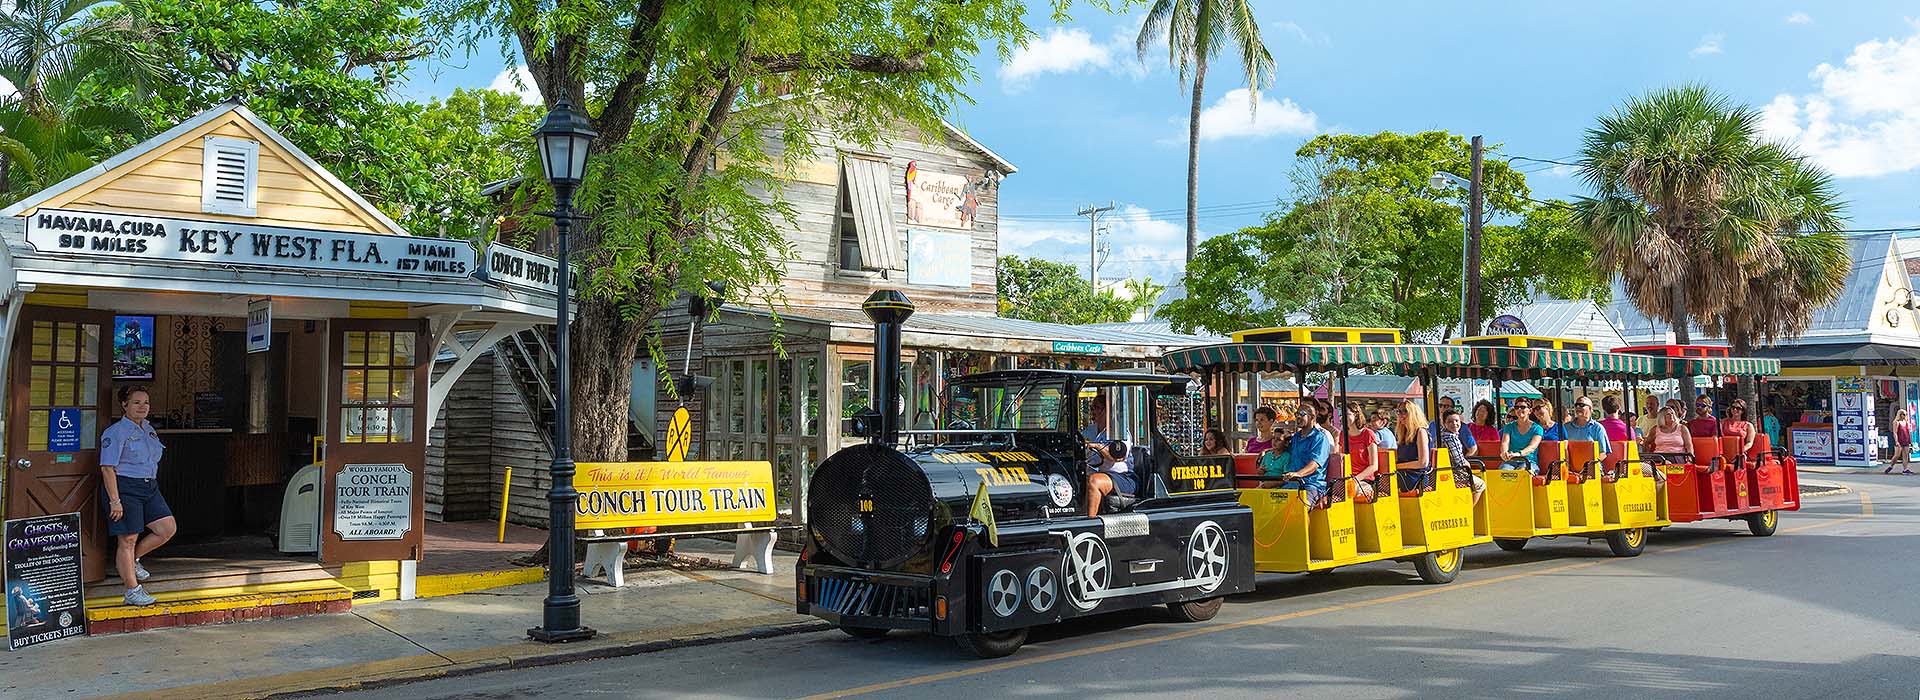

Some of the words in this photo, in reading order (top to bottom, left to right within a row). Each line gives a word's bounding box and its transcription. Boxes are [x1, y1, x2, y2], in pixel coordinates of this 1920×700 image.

[920, 180, 959, 195] Caribbean
[932, 194, 955, 210] Cargo
[58, 234, 85, 248] 90
[90, 236, 148, 253] MILES
[179, 227, 242, 255] KEY
[331, 239, 389, 265] FLA.
[408, 243, 456, 259] MIAMI
[396, 258, 420, 271] 157
[424, 260, 467, 274] MILES
[491, 251, 524, 278] CONCH
[525, 259, 550, 284] TOUR
[1488, 327, 1526, 336] MALLORY
[668, 428, 675, 445] R
[683, 431, 689, 447] R
[932, 451, 991, 464] CONCH
[988, 451, 1039, 462] TOUR
[351, 474, 397, 485] CONCH
[588, 467, 613, 482] This
[620, 469, 630, 481] is
[635, 467, 653, 481] it!
[661, 466, 700, 481] World
[703, 467, 750, 480] Famous
[976, 467, 1031, 487] TRAIN
[1171, 465, 1208, 480] OVERSEAS
[1209, 464, 1225, 478] R.R.
[339, 486, 370, 496] TOUR
[374, 486, 410, 496] TRAIN
[1193, 478, 1205, 490] 108
[575, 489, 646, 515] CONCH
[652, 488, 706, 512] TOUR
[709, 487, 766, 511] TRAIN
[859, 499, 873, 512] 108
[24, 522, 63, 536] GHOSTS
[1430, 518, 1458, 531] OVERSEAS
[8, 531, 79, 550] GRAVESTONES
[14, 636, 30, 648] BUY
[30, 630, 62, 645] TICKETS
[63, 625, 83, 637] HERE
